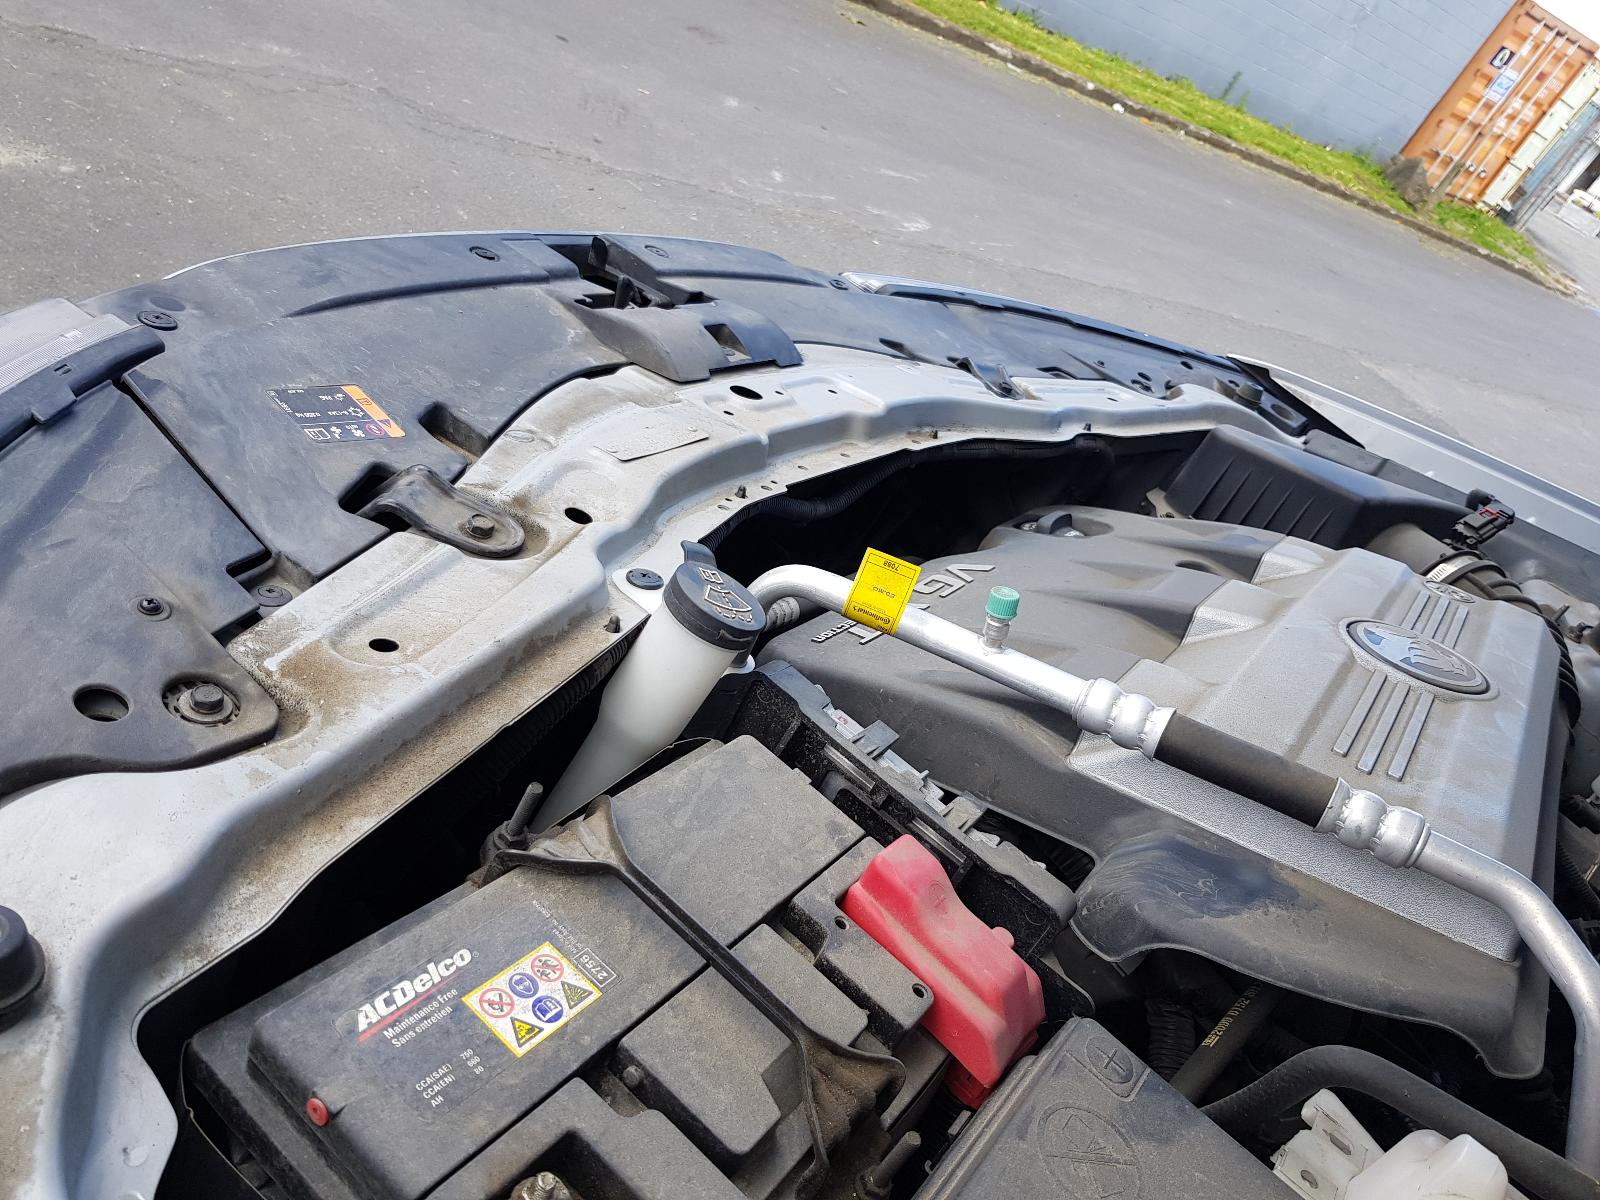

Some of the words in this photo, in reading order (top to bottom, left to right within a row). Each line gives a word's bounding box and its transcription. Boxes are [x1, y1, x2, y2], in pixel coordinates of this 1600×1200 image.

[912, 563, 996, 598] V6
[580, 954, 608, 980] 2756
[357, 948, 472, 1033] ACDelco
[383, 1001, 440, 1040] Maintenance
[437, 988, 459, 1004] Free
[391, 1031, 416, 1048] Sans
[415, 1005, 453, 1034] entretien
[415, 1063, 453, 1091] CCA(SAE)
[460, 1048, 473, 1060] 750
[422, 1073, 456, 1099] CCA(EN)
[430, 1095, 444, 1108] AH
[474, 1065, 485, 1075] 80
